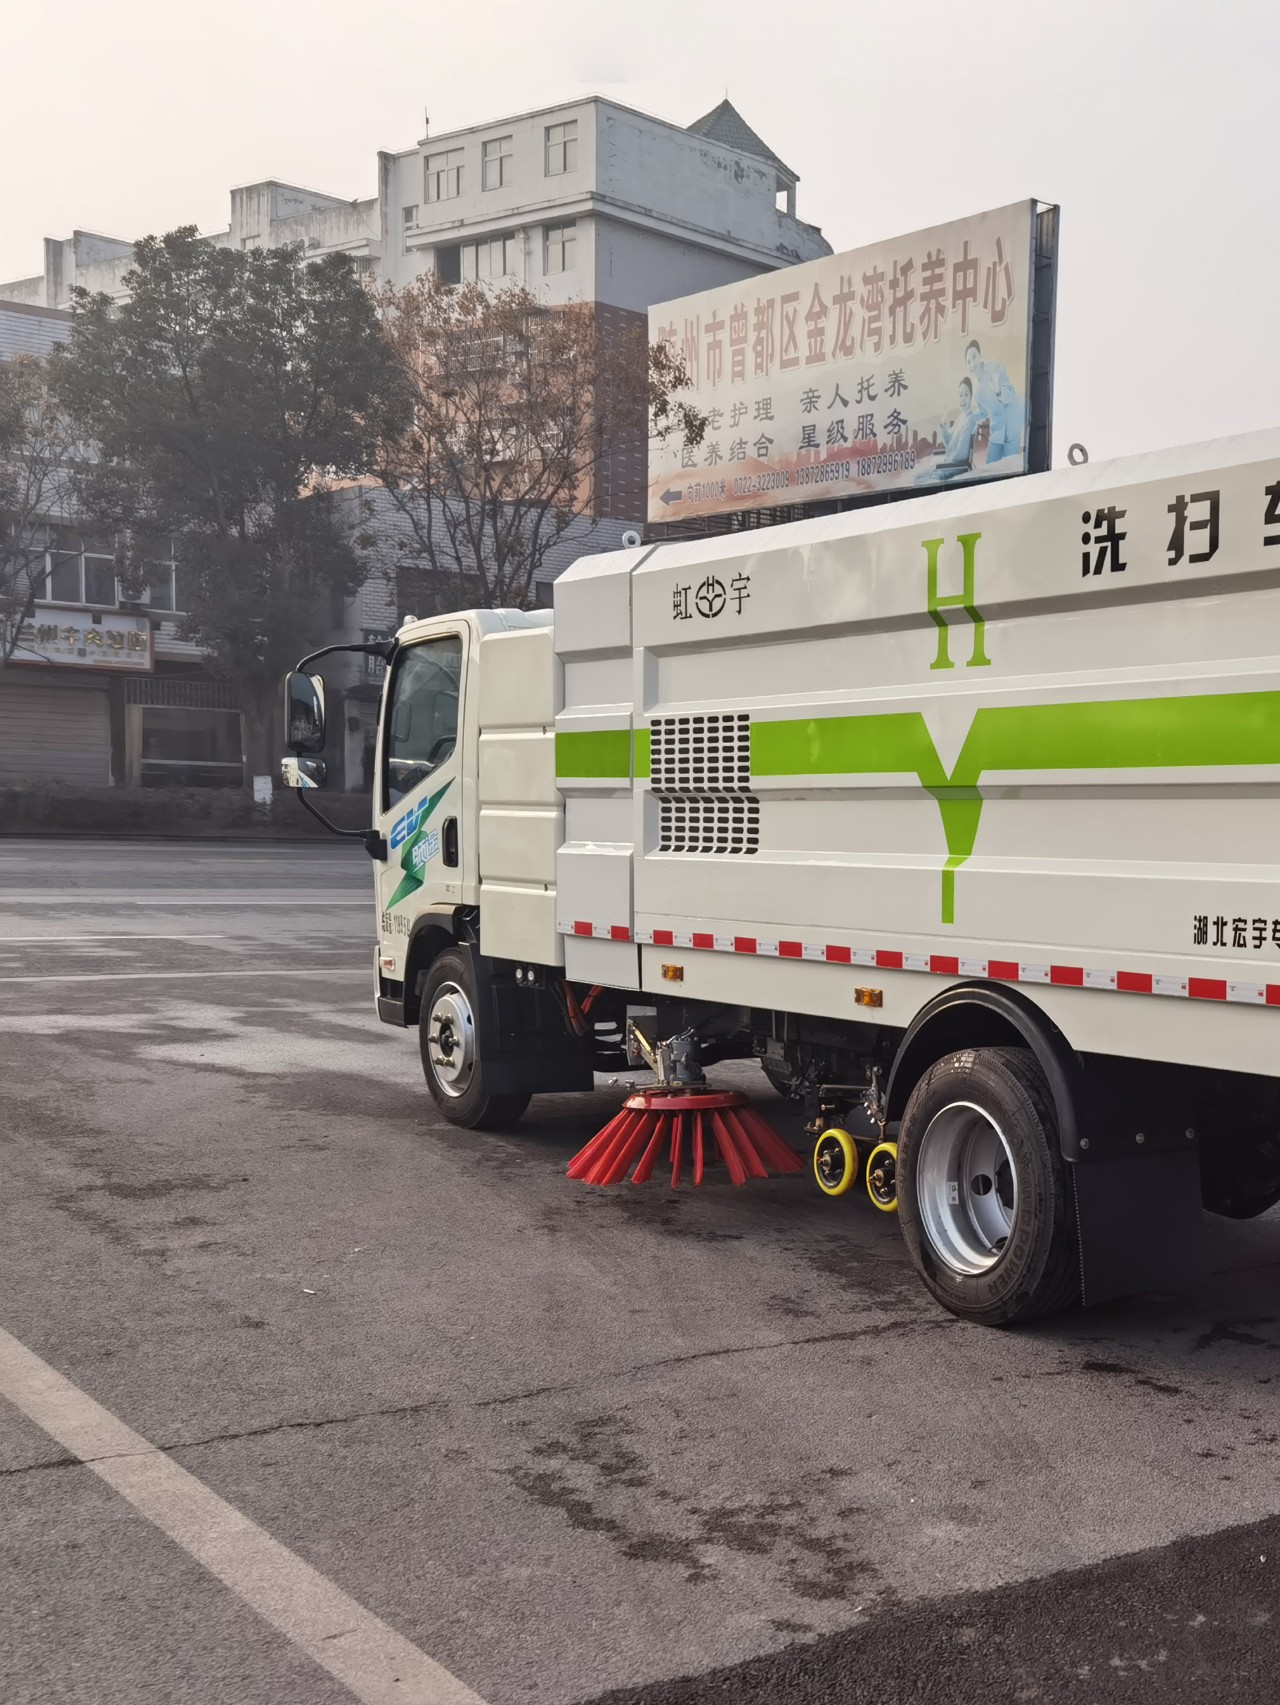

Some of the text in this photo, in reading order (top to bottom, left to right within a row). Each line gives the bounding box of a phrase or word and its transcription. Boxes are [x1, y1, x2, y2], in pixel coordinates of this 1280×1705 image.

[692, 368, 909, 431] 老护理 亲人托养
[682, 408, 909, 469] 医养结合 星级服务
[734, 470, 790, 495] 0722-3223009
[795, 461, 850, 486] 13872865919
[857, 450, 916, 477] 18872996189
[390, 795, 429, 850] EV
